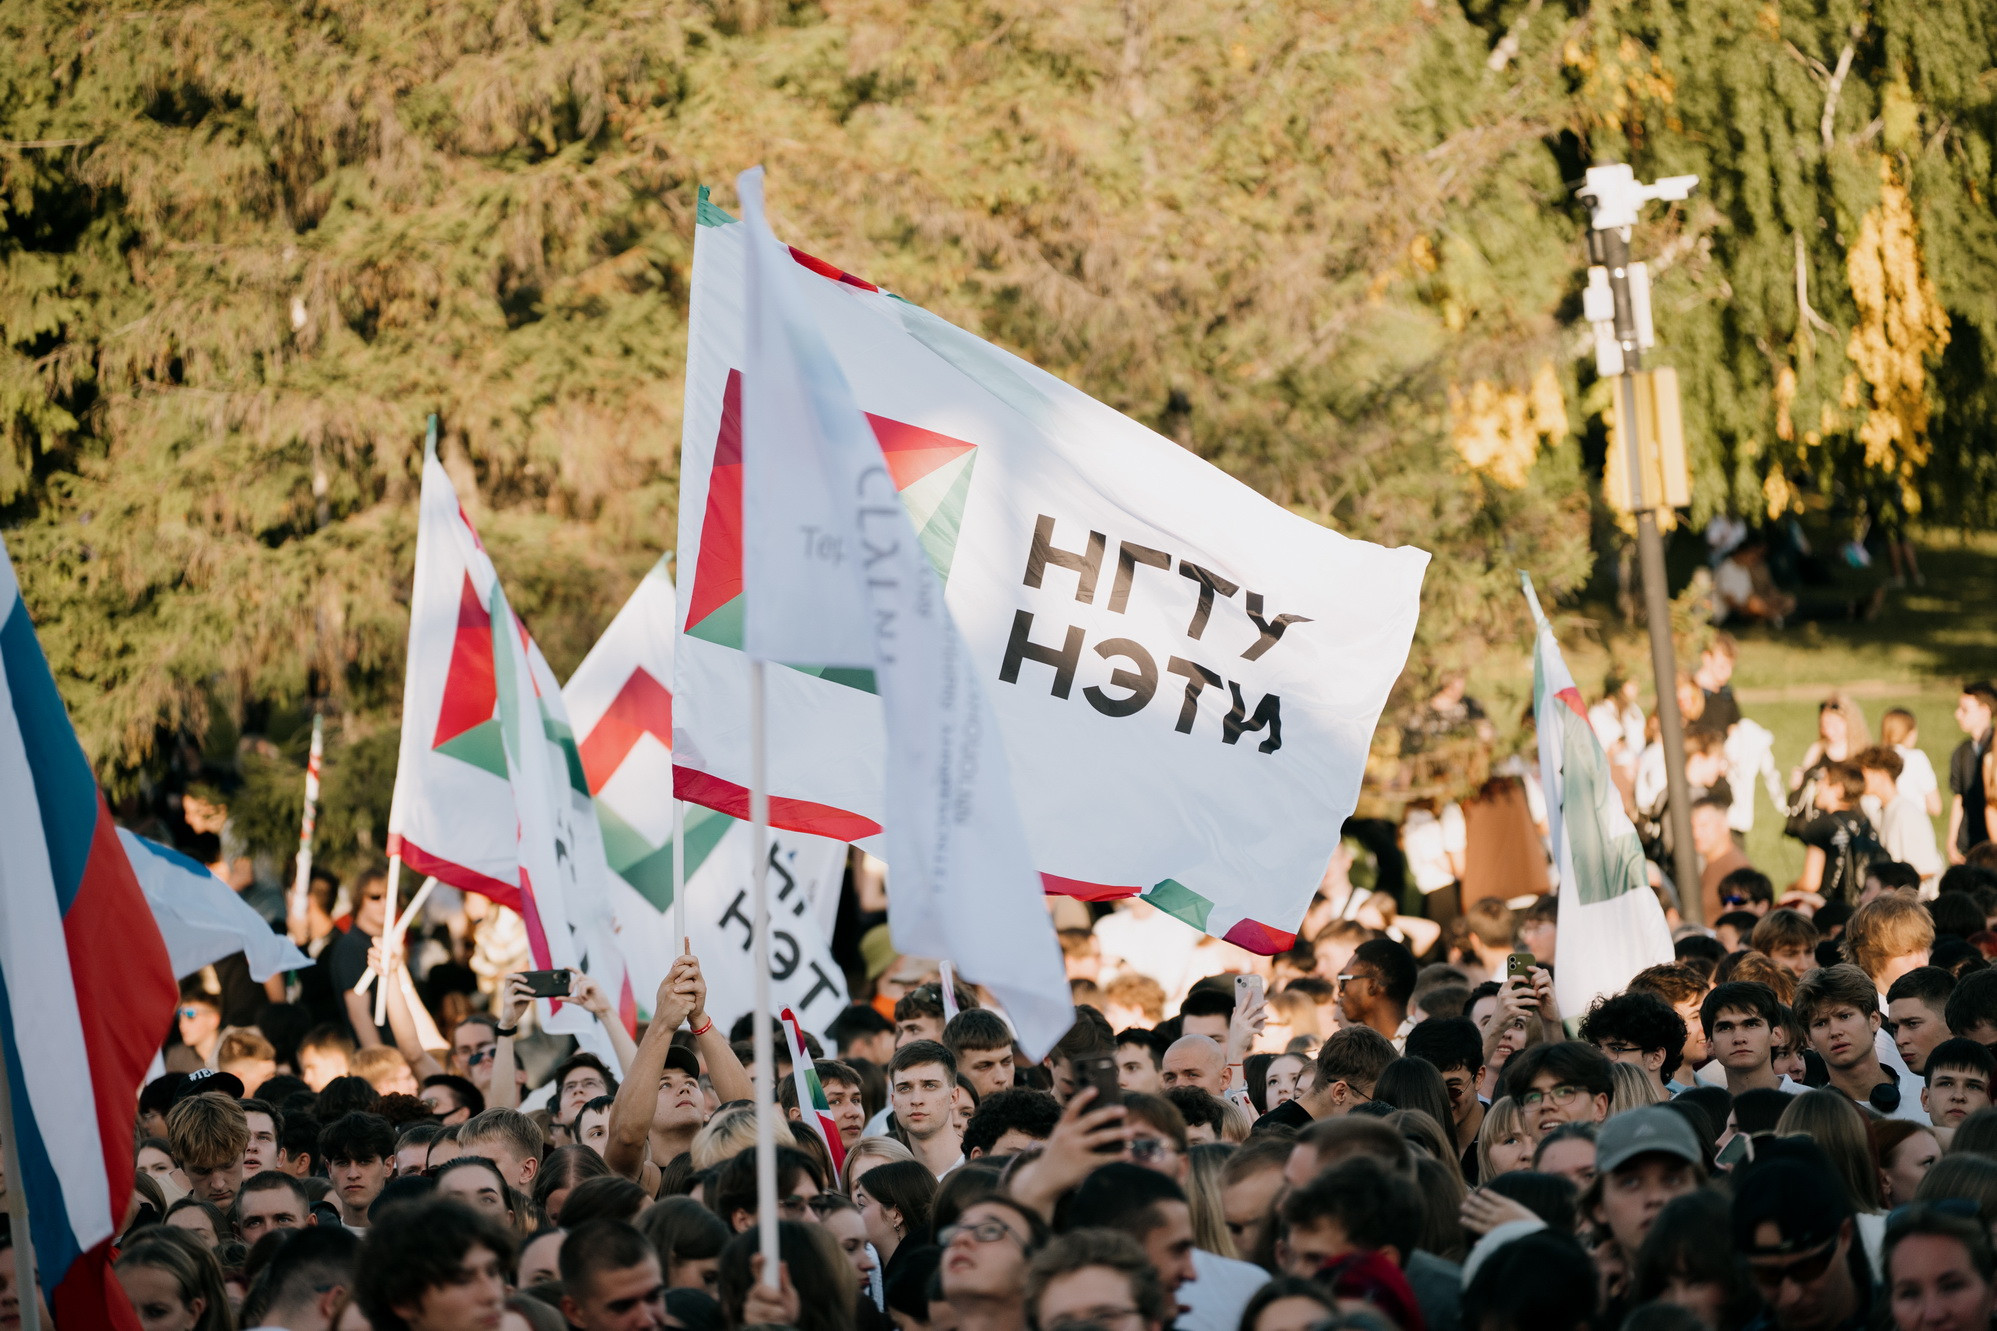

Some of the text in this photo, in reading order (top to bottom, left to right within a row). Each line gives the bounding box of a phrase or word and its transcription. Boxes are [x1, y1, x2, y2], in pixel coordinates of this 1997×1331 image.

[1023, 513, 1315, 662] НГТУ
[998, 609, 1282, 755] НЭТИ
[718, 889, 850, 1040] НЭТ
